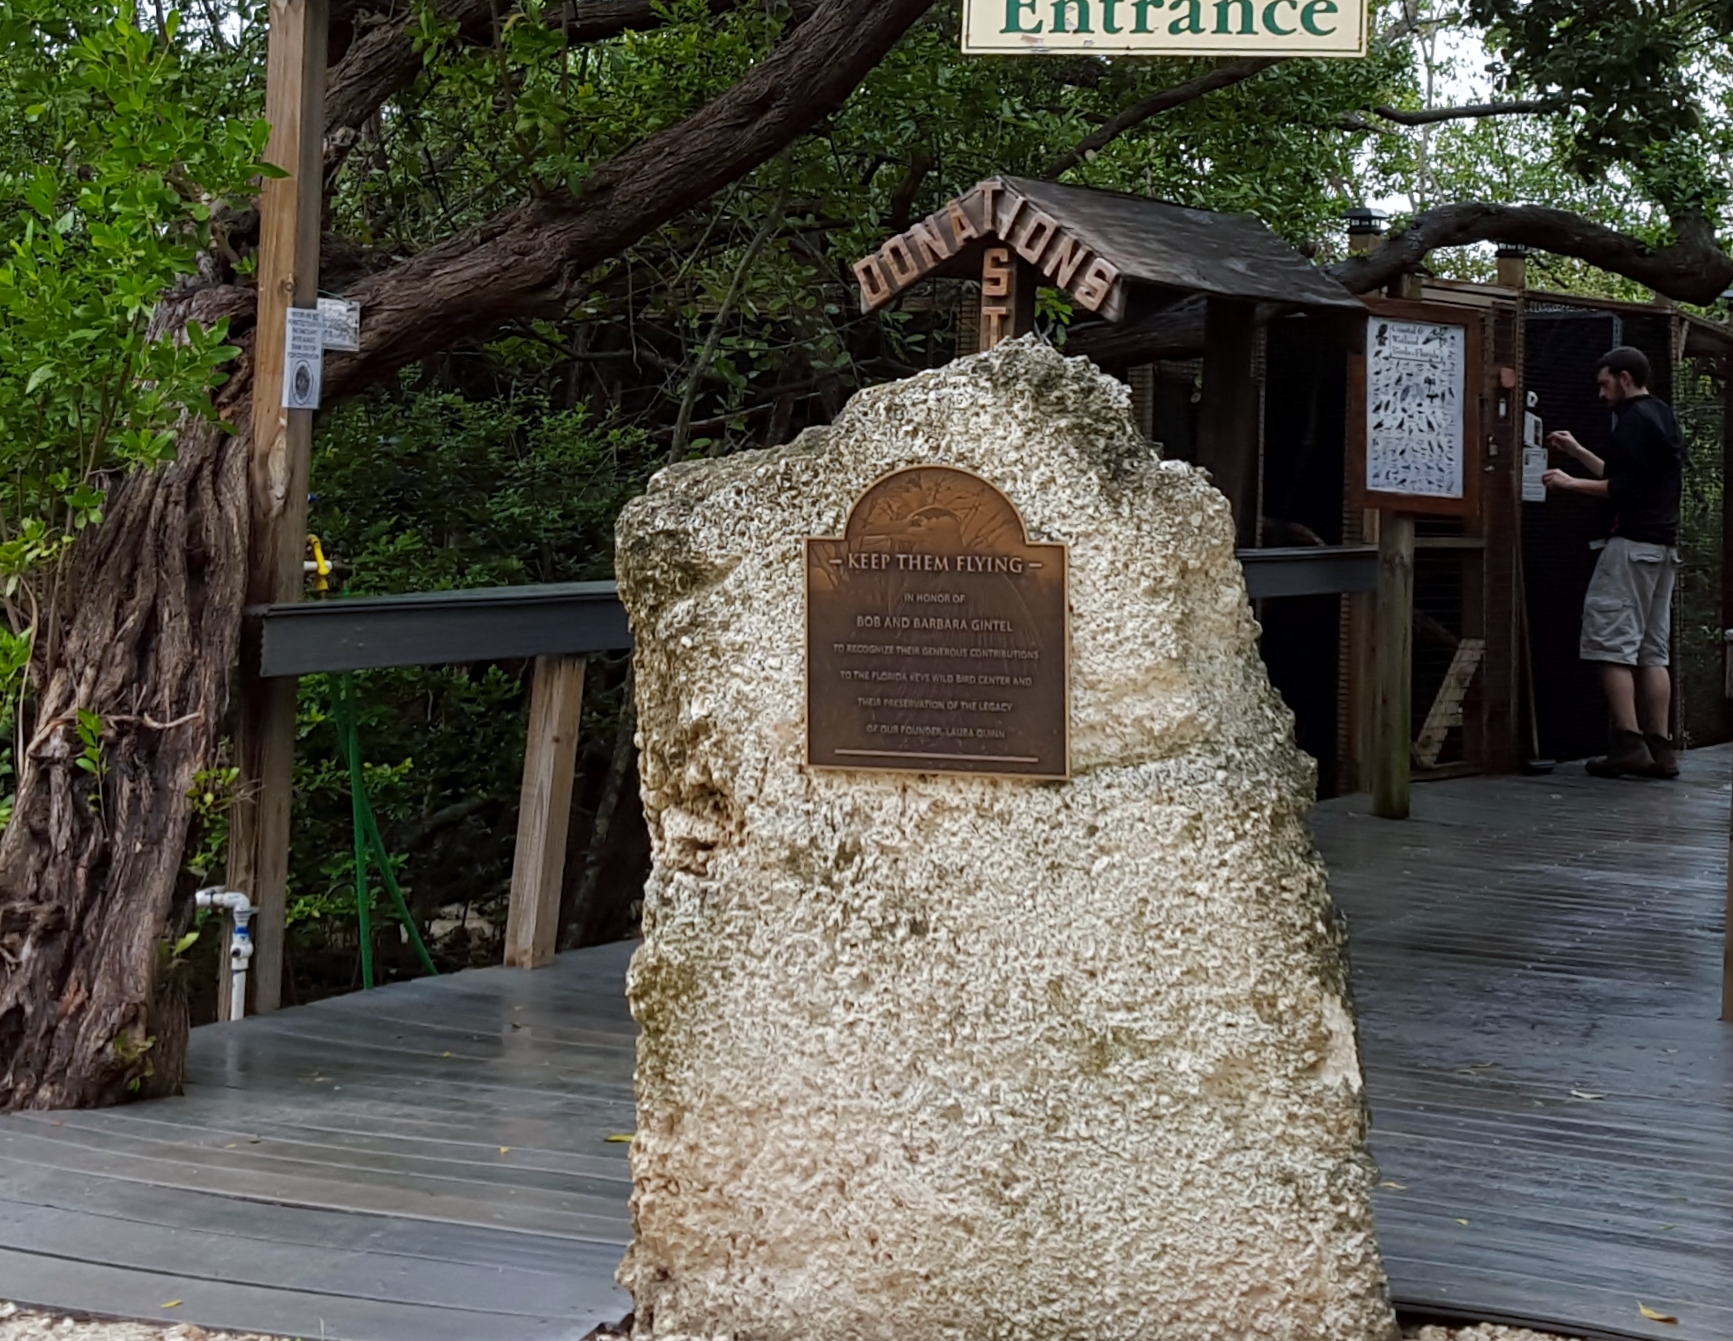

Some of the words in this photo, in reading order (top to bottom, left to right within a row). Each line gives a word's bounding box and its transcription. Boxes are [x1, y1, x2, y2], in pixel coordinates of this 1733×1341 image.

[852, 181, 1120, 312] DONATIONS
[848, 552, 891, 570] KEEP
[896, 553, 949, 572] THEM
[957, 555, 1023, 574] FLYING
[904, 592, 914, 603] IN
[916, 592, 950, 604] HONOR
[952, 593, 966, 604] OF
[856, 615, 881, 628] BOB
[884, 616, 910, 629] AND
[913, 617, 967, 631] BARBARA
[971, 619, 1013, 632] GINTEL
[833, 643, 844, 653] TO
[846, 644, 894, 655] RECOGNIZE
[896, 645, 920, 656] THEIR
[922, 646, 968, 658] GENEROUS
[970, 648, 1039, 660] CONTRIBUTIONS
[840, 670, 852, 679] TO
[853, 670, 870, 680] THE
[871, 671, 907, 681] FLORIDA
[909, 672, 930, 682] KEYS
[931, 673, 954, 683] WILD
[956, 674, 976, 685] BIRD
[978, 675, 1010, 686] CENTER
[1012, 676, 1033, 687] AND
[858, 697, 881, 707] THEIR
[883, 698, 945, 710] PRESERVATION
[947, 700, 959, 710] OF
[960, 700, 977, 711] THE
[979, 701, 1013, 713] LEGACY
[866, 724, 879, 734] OF
[880, 724, 899, 734] OUR
[946, 726, 974, 738] LAURA
[976, 727, 1006, 739] QUINN
